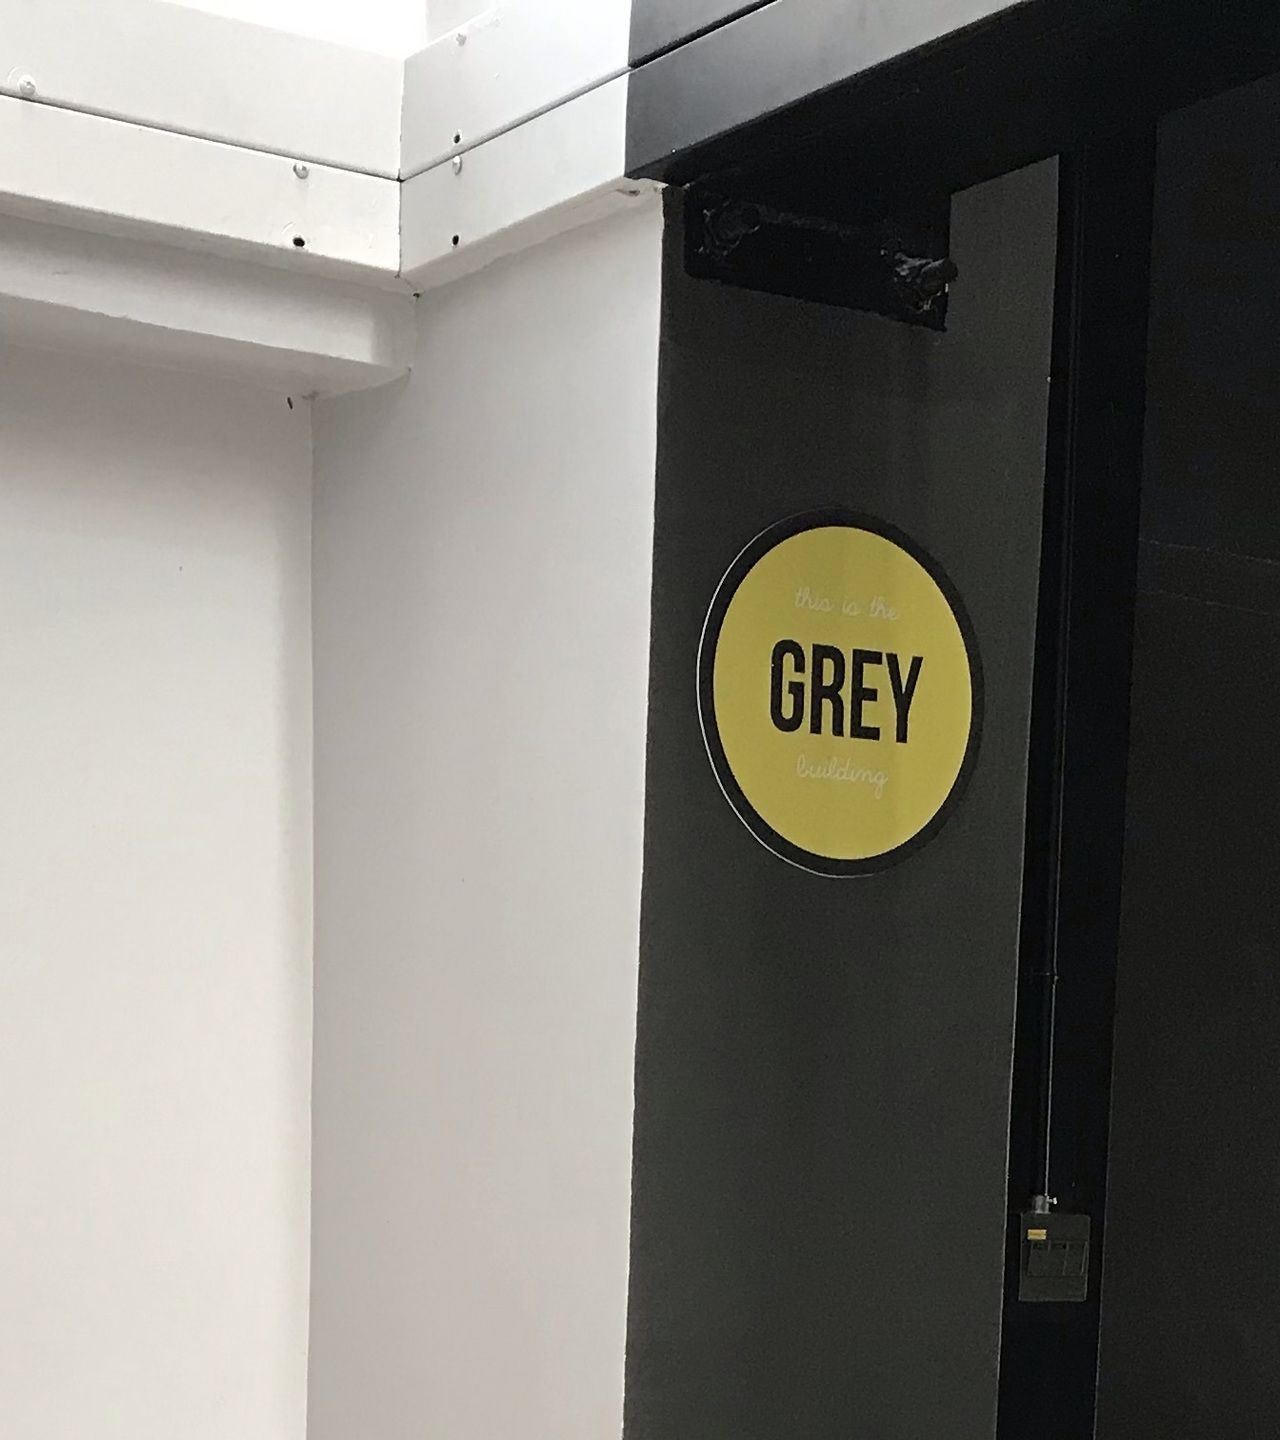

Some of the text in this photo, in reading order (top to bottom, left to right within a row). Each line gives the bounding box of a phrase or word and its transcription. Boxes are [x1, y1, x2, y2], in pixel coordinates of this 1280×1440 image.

[795, 587, 898, 620] this is the
[770, 639, 923, 744] GREY
[796, 752, 888, 800] building
